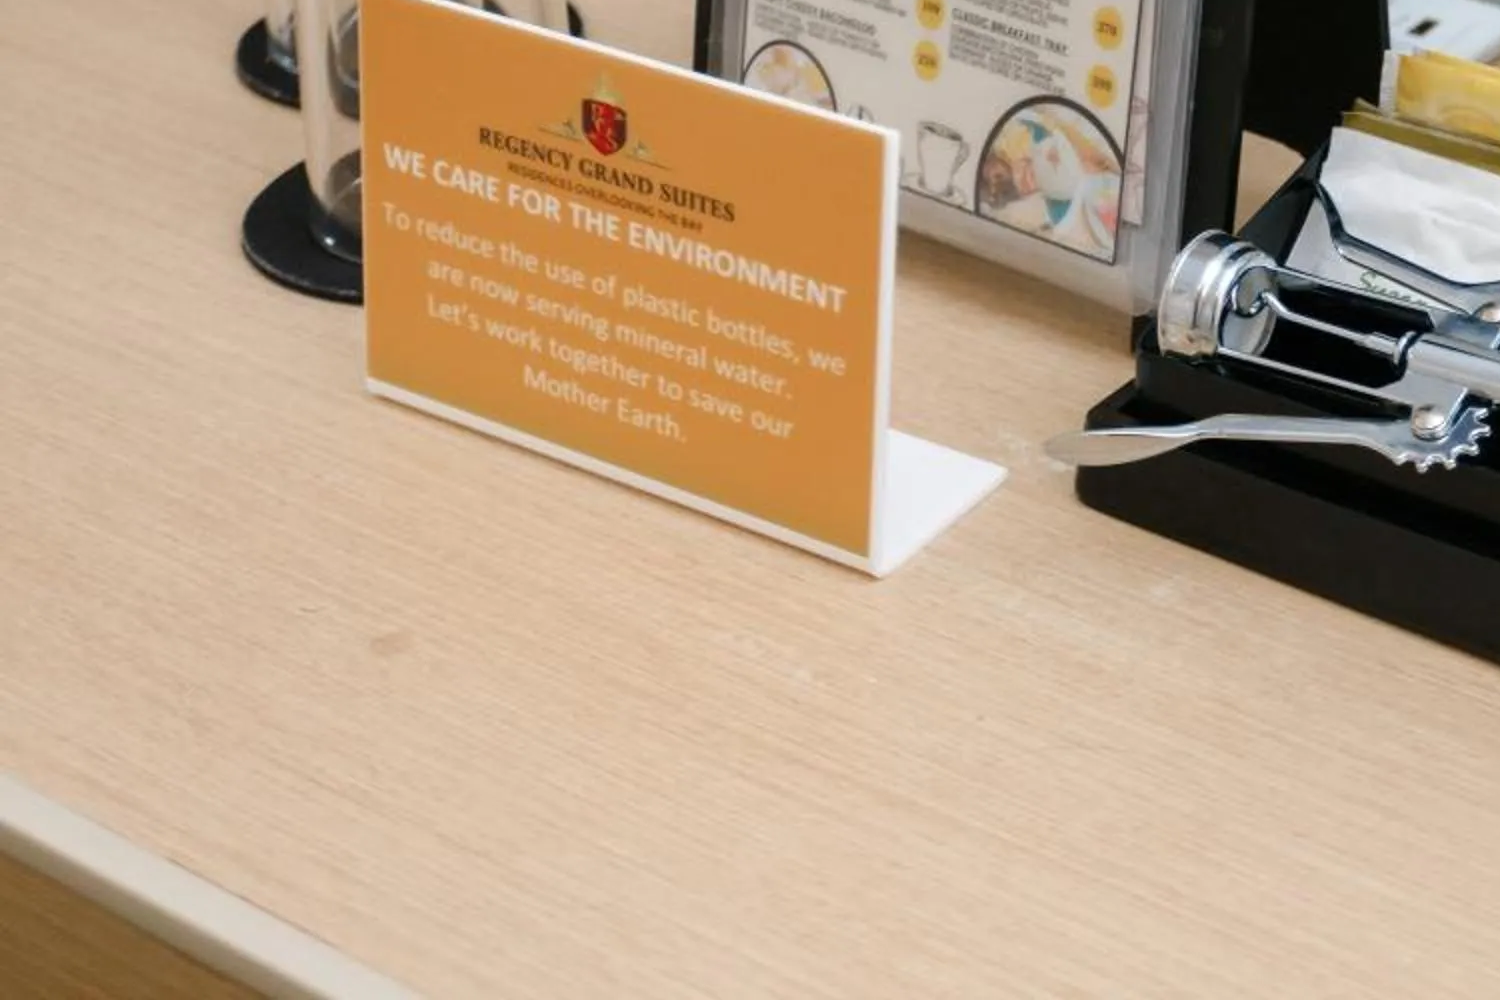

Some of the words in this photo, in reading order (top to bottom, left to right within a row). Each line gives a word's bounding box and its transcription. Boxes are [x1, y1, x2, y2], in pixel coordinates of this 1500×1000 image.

[383, 143, 426, 181] WE
[433, 160, 500, 202] CARE
[507, 183, 561, 225] FOR
[569, 203, 621, 242] THE
[628, 223, 847, 313] ENVIRONMENT
[479, 127, 574, 172] REGENCY
[578, 157, 653, 196] GRAND
[659, 183, 736, 222] SUITES
[507, 161, 573, 192] RESIDENCES
[573, 183, 655, 218] OVERLOOKING
[657, 207, 678, 225] THE
[382, 203, 411, 232] To
[417, 212, 495, 259] reduce
[500, 235, 538, 275] the
[545, 260, 586, 290] use
[592, 271, 616, 298] of
[623, 285, 700, 328] plastic
[707, 304, 800, 365] bottles,
[808, 347, 847, 378] we
[427, 261, 464, 289] are
[469, 271, 520, 306] now
[526, 287, 609, 342] serving
[615, 320, 707, 370] mineral
[714, 354, 794, 400] water.
[427, 294, 480, 332] Let's
[486, 312, 542, 357] work
[549, 337, 650, 389] together
[657, 373, 683, 400] to
[688, 390, 743, 424] save
[751, 409, 794, 439] our
[523, 365, 611, 416] Mother
[617, 399, 687, 443] Earth.
